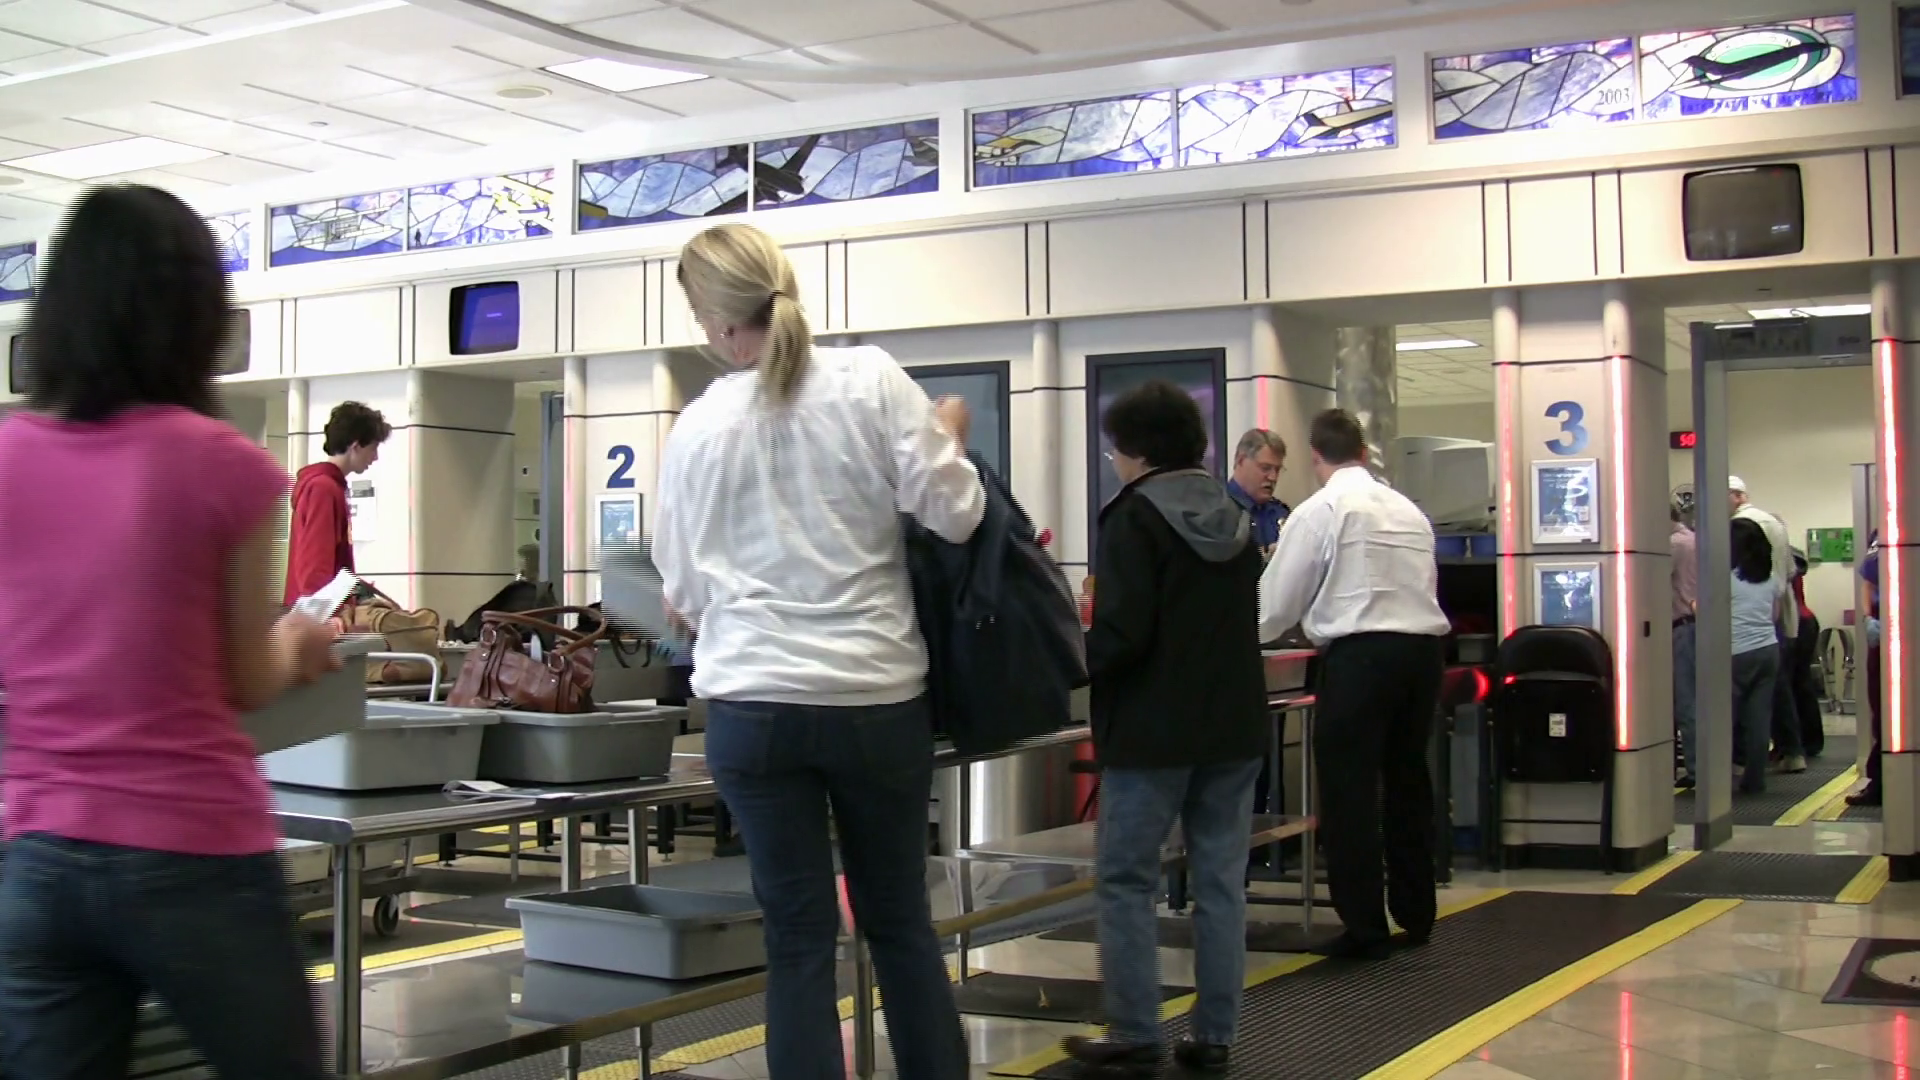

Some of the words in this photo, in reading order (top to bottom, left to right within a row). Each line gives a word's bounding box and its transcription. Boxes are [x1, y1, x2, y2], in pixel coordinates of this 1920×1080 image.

[1597, 87, 1630, 106] 2003
[1544, 400, 1588, 456] 3
[606, 444, 636, 489] 2
